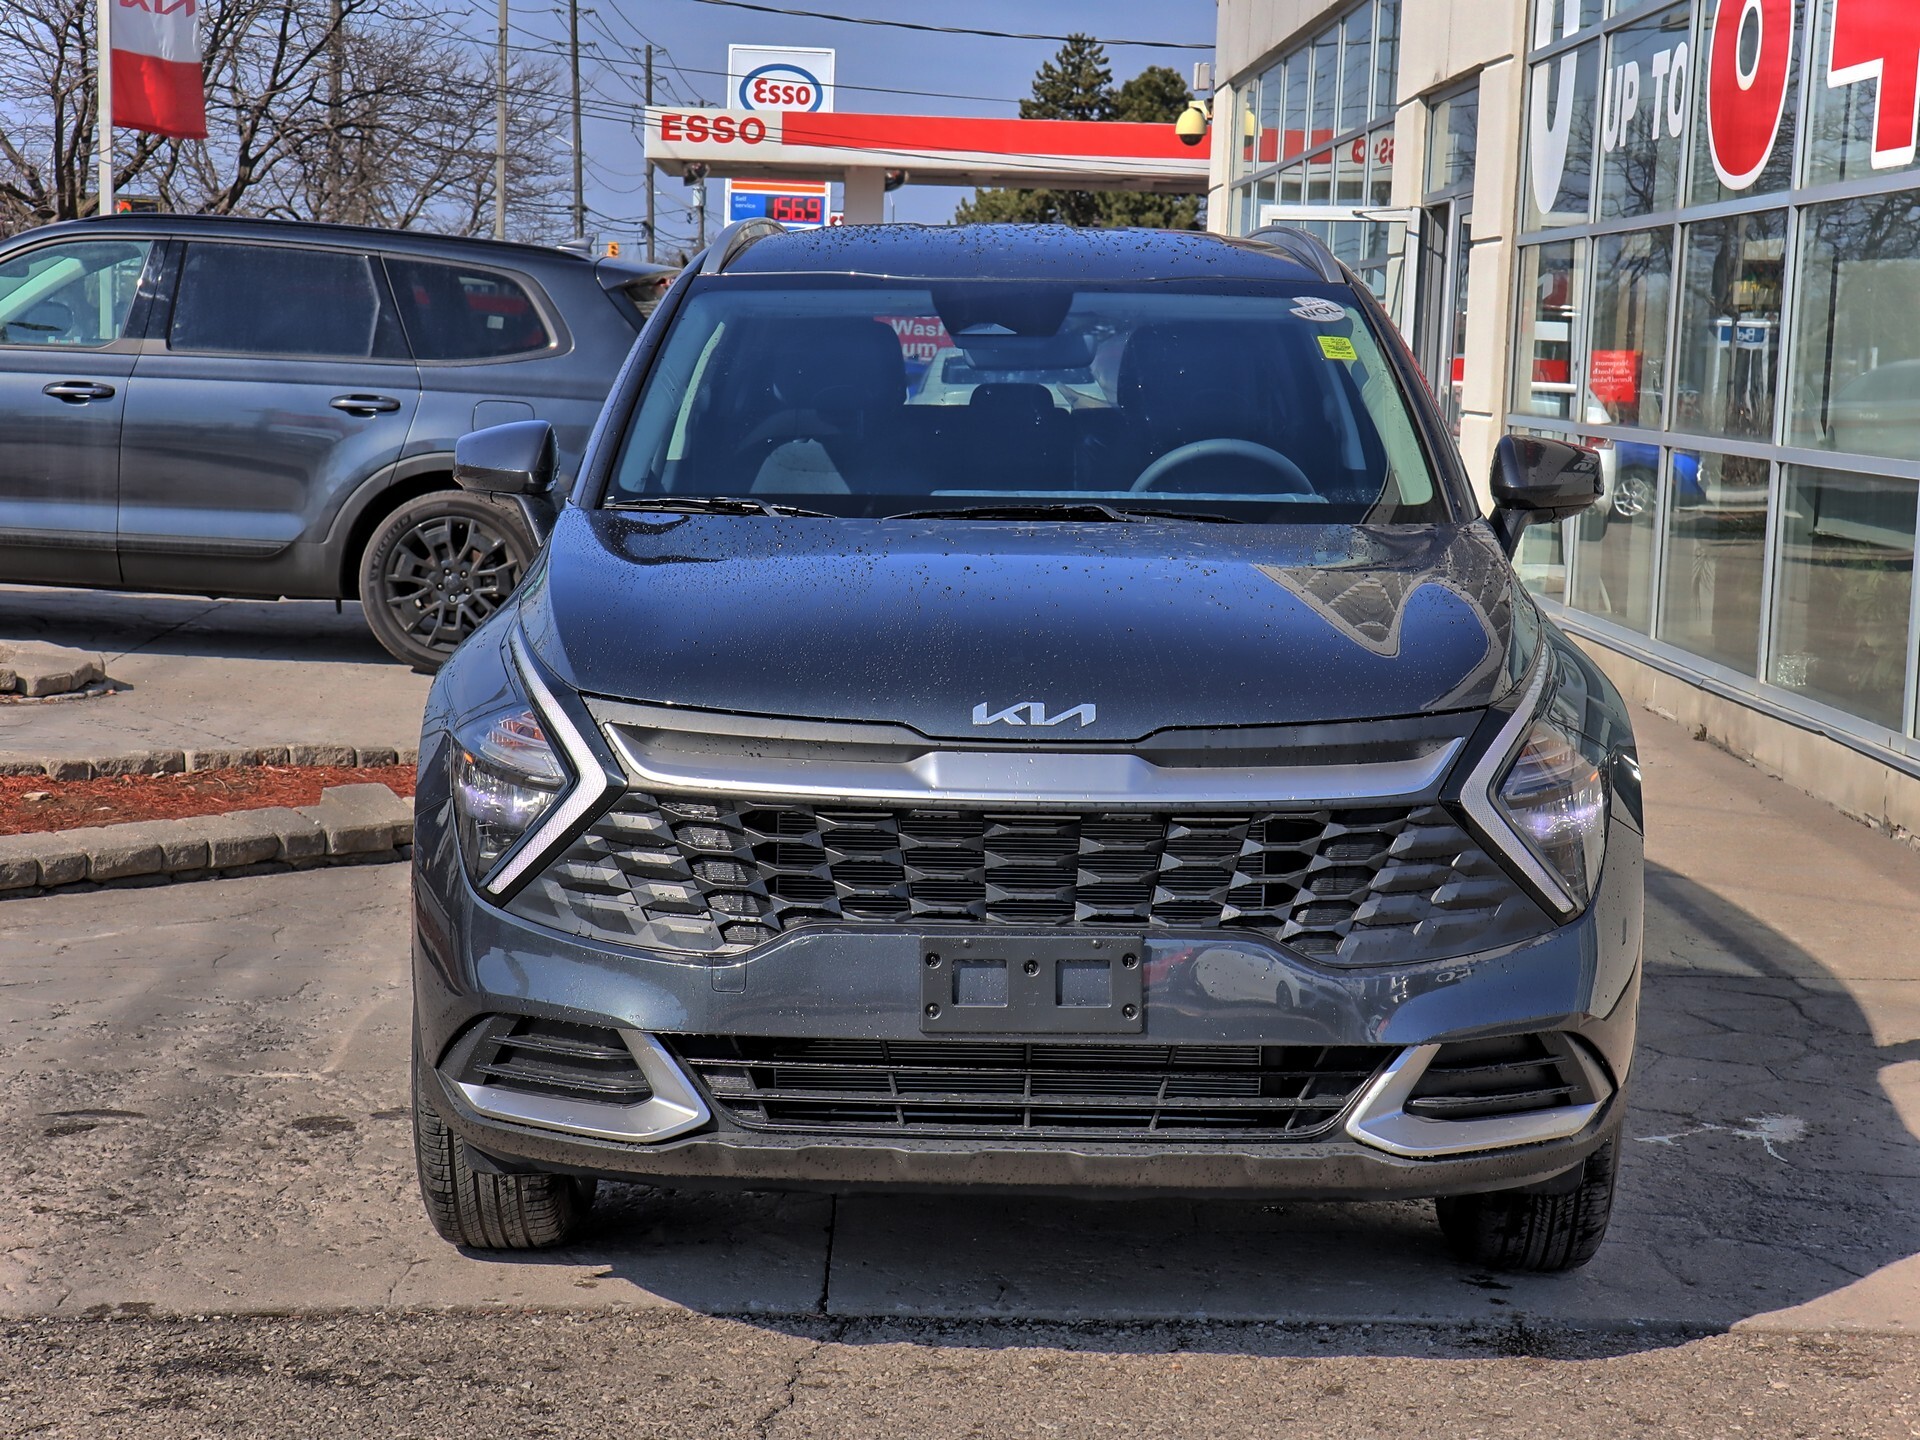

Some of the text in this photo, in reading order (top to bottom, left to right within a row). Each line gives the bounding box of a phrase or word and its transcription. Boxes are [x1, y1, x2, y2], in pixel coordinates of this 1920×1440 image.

[753, 78, 811, 106] Esso
[1603, 41, 1688, 152] UP TO
[660, 114, 766, 145] ESSO
[773, 197, 821, 223] 156.9
[972, 701, 1096, 727] KIA
